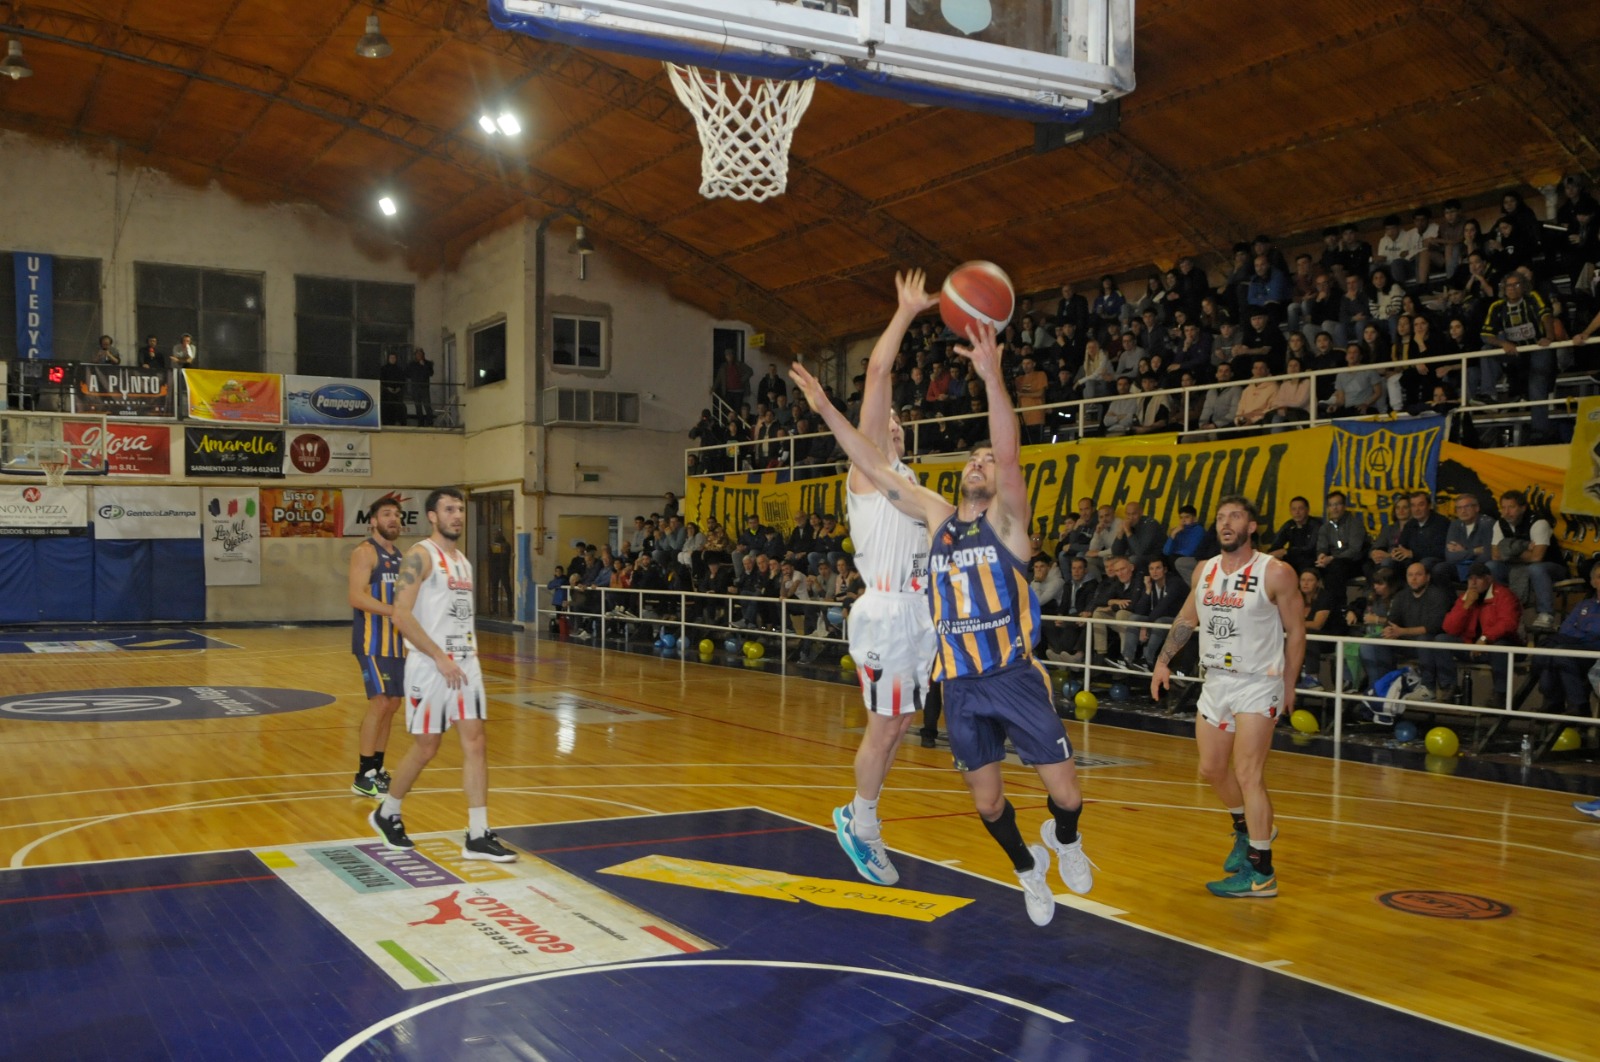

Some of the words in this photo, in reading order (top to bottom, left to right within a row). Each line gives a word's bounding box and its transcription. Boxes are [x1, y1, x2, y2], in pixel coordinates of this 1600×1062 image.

[89, 374, 99, 392] A
[108, 368, 160, 400] PUNTO
[316, 395, 367, 411] Pampagua
[194, 434, 277, 454] Amarella
[284, 491, 314, 501] LISTO
[1091, 443, 1288, 534] TERMINA
[35, 505, 68, 514] PIZZA
[273, 507, 325, 522] POLLO
[953, 545, 998, 568] BOYS
[950, 571, 971, 613] 7
[1233, 574, 1258, 592] 22
[1203, 591, 1244, 608] Colón
[952, 615, 1010, 635] ALTAMIRANO
[1056, 738, 1070, 758] 7
[342, 863, 395, 888] BUENOS
[799, 884, 835, 894] de
[843, 892, 936, 909] Banco
[465, 897, 575, 953] GONZALO
[471, 921, 530, 955] EXPRESO
